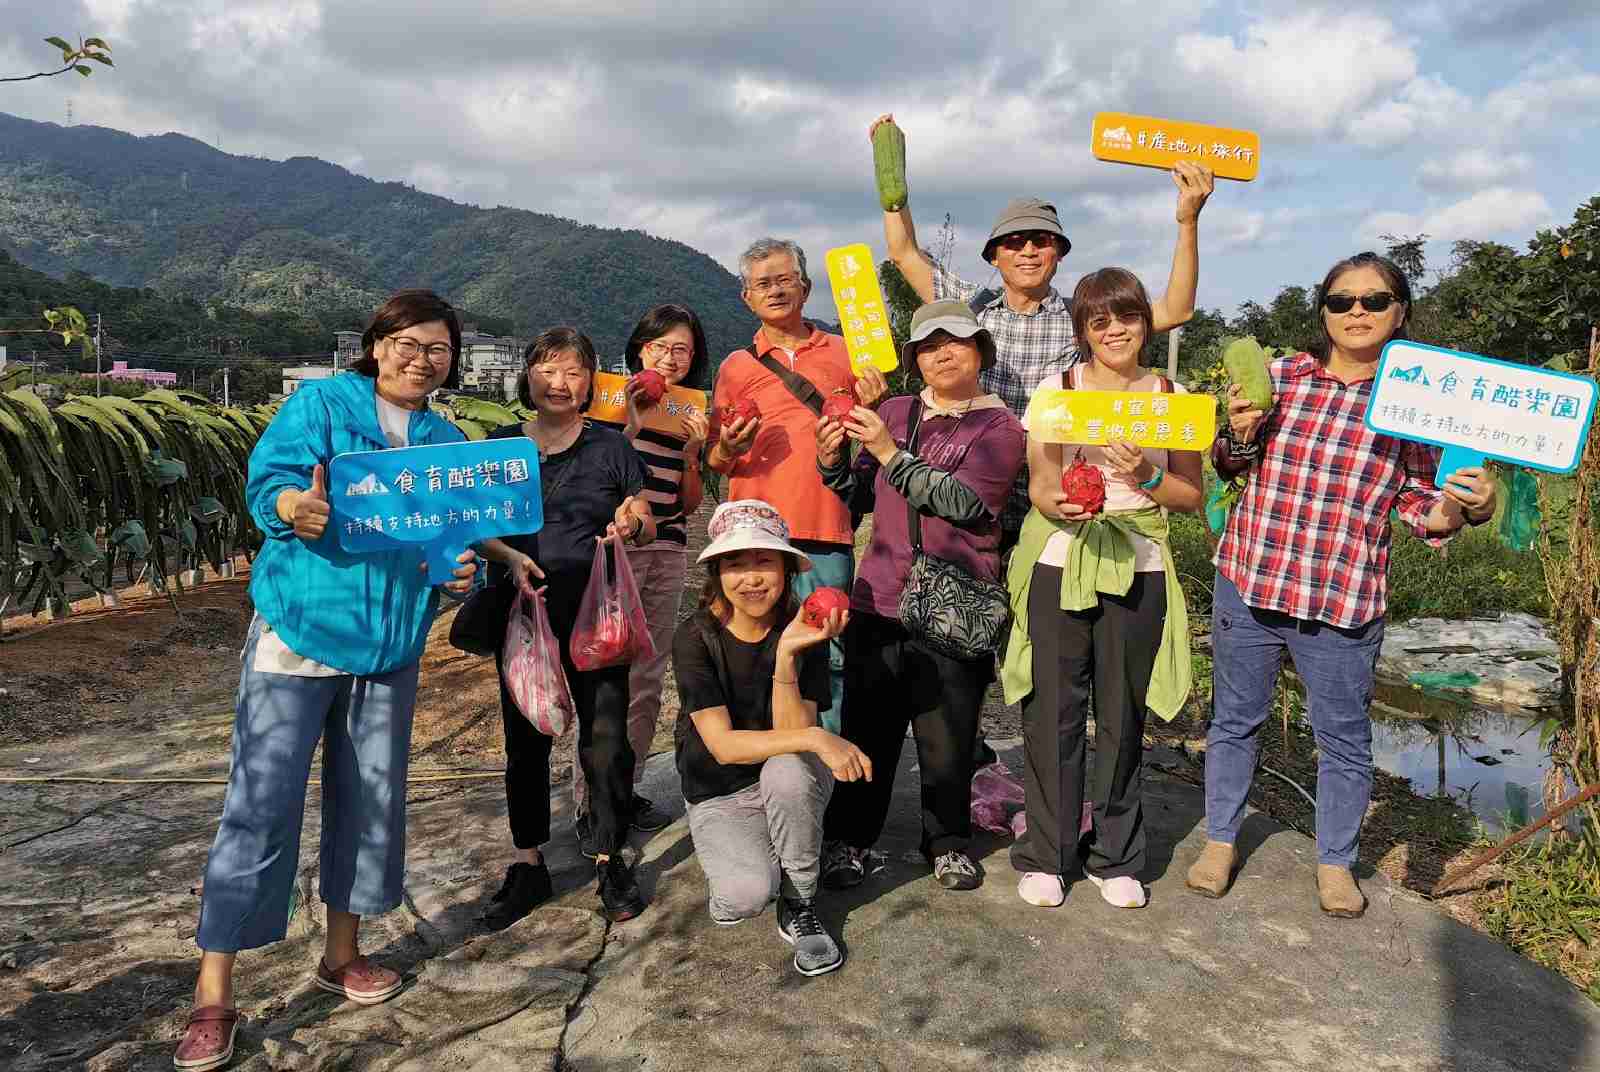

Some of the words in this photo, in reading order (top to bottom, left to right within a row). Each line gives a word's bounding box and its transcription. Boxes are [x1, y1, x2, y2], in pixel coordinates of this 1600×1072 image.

[1438, 369, 1580, 419] 食育酷樂園
[394, 457, 529, 495] 食育酷樂園
